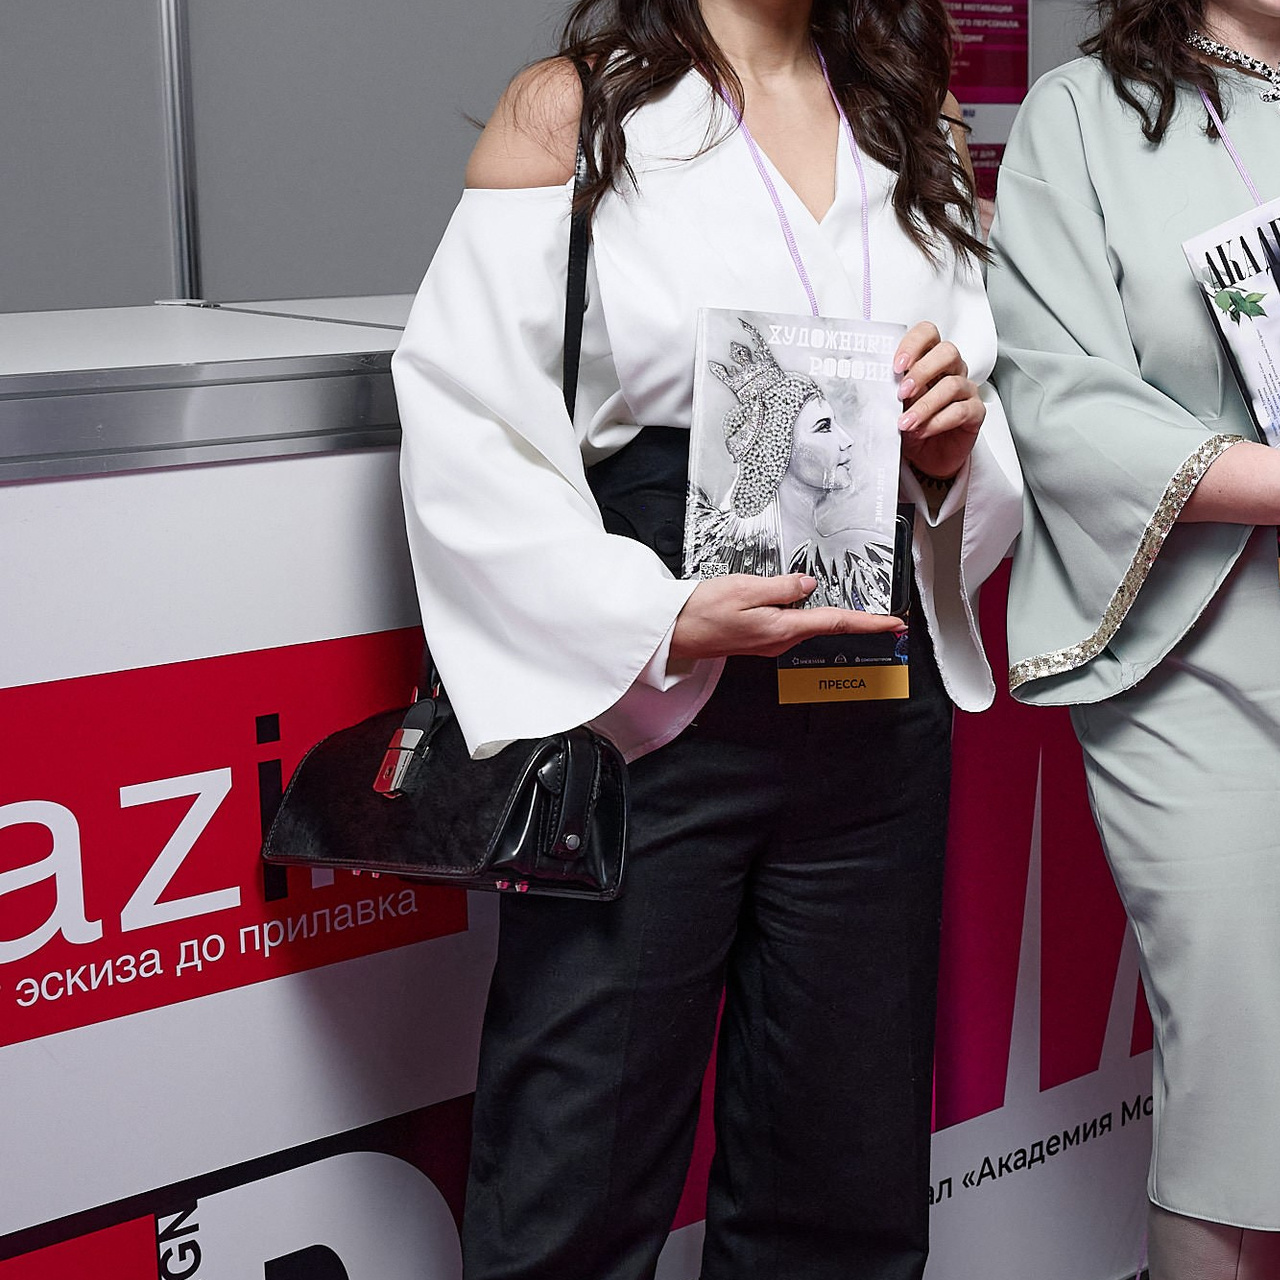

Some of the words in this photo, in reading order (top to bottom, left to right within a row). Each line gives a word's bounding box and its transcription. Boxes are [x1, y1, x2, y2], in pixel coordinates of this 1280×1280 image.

[768, 323, 894, 355] ХУДОЖНИКИ
[808, 356, 893, 383] РОССИИ
[818, 679, 867, 690] ПРЕССА
[15, 948, 163, 1008] эскиза
[176, 934, 226, 976] до
[239, 888, 418, 958] прилавка
[962, 1112, 1113, 1189] «Академия
[1121, 1094, 1154, 1127] Мо
